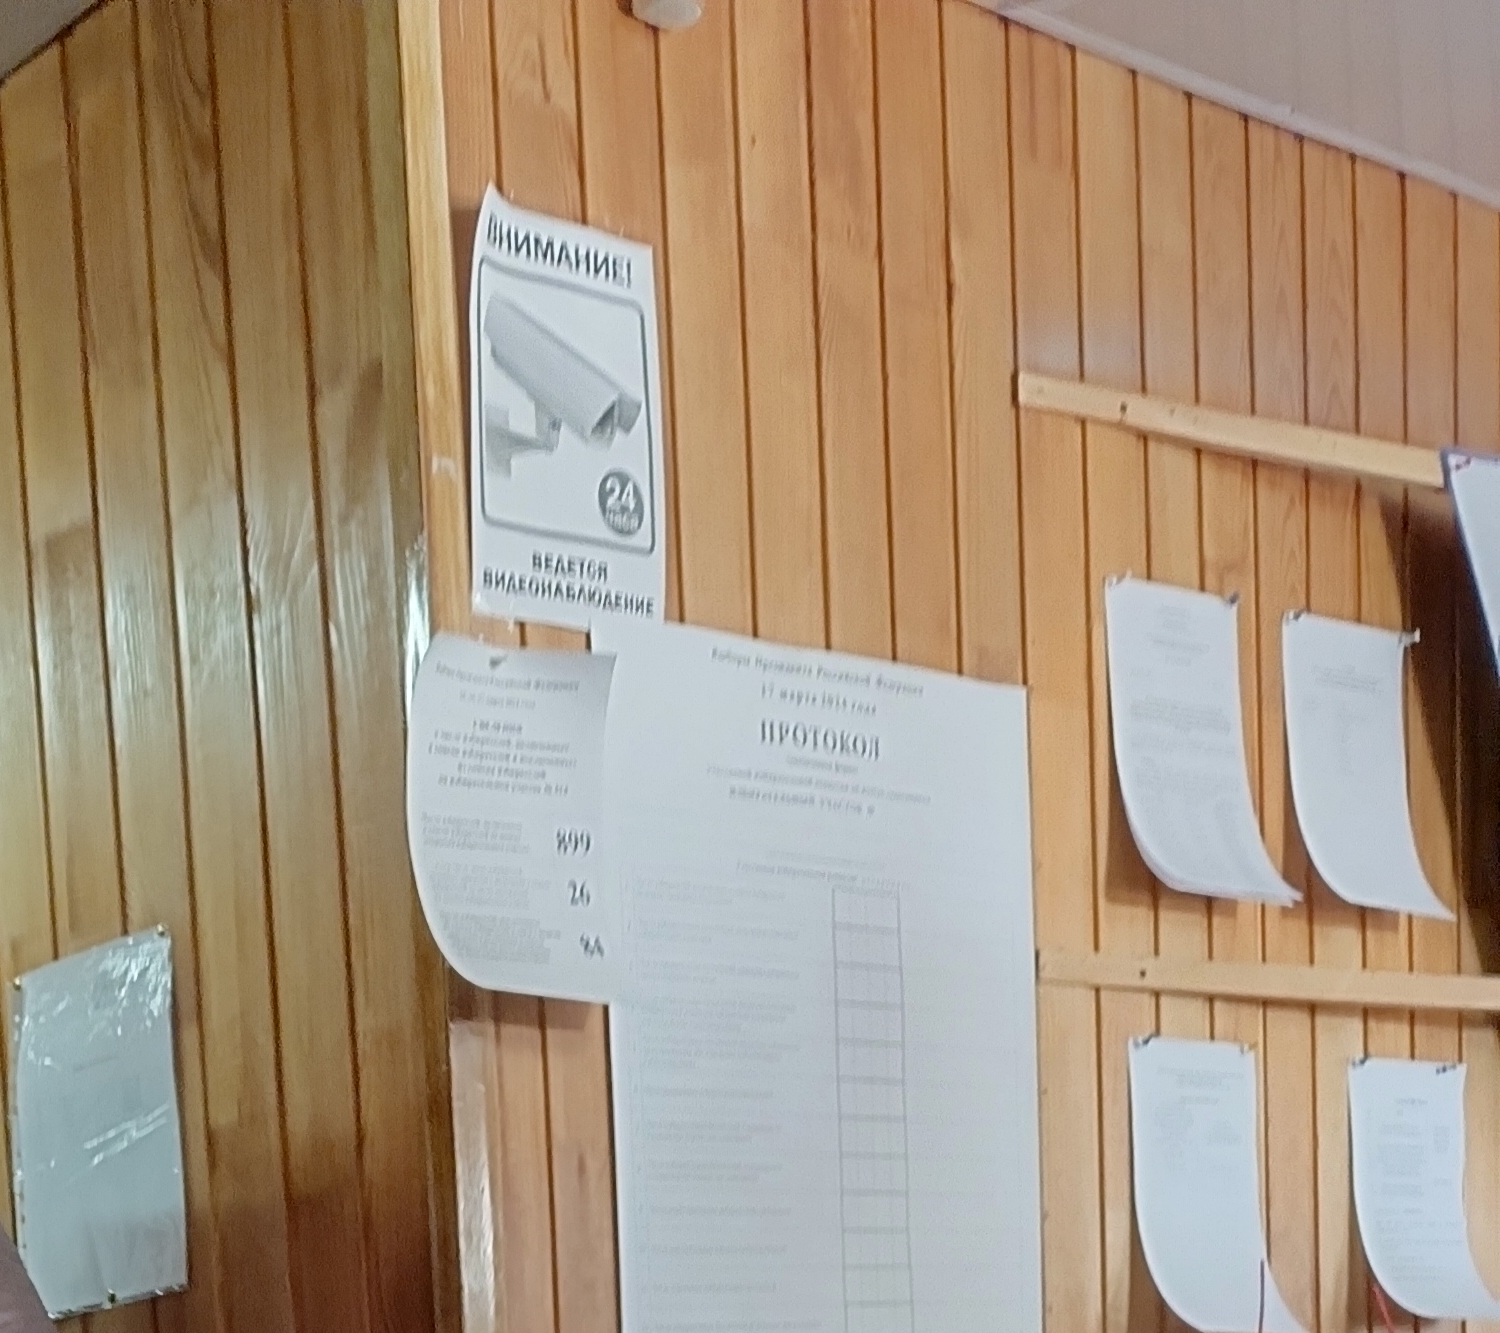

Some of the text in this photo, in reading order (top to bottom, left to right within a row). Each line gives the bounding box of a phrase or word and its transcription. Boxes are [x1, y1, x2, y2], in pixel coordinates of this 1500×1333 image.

[487, 213, 632, 289] ВНИМАНИЕ!
[605, 476, 637, 513] 24
[532, 549, 608, 584] ВЕДЕТСЯ
[483, 565, 654, 618] ВИДЕОНАБЛЮДЕНИЕ
[760, 718, 880, 761] ПРОТОКОЛ
